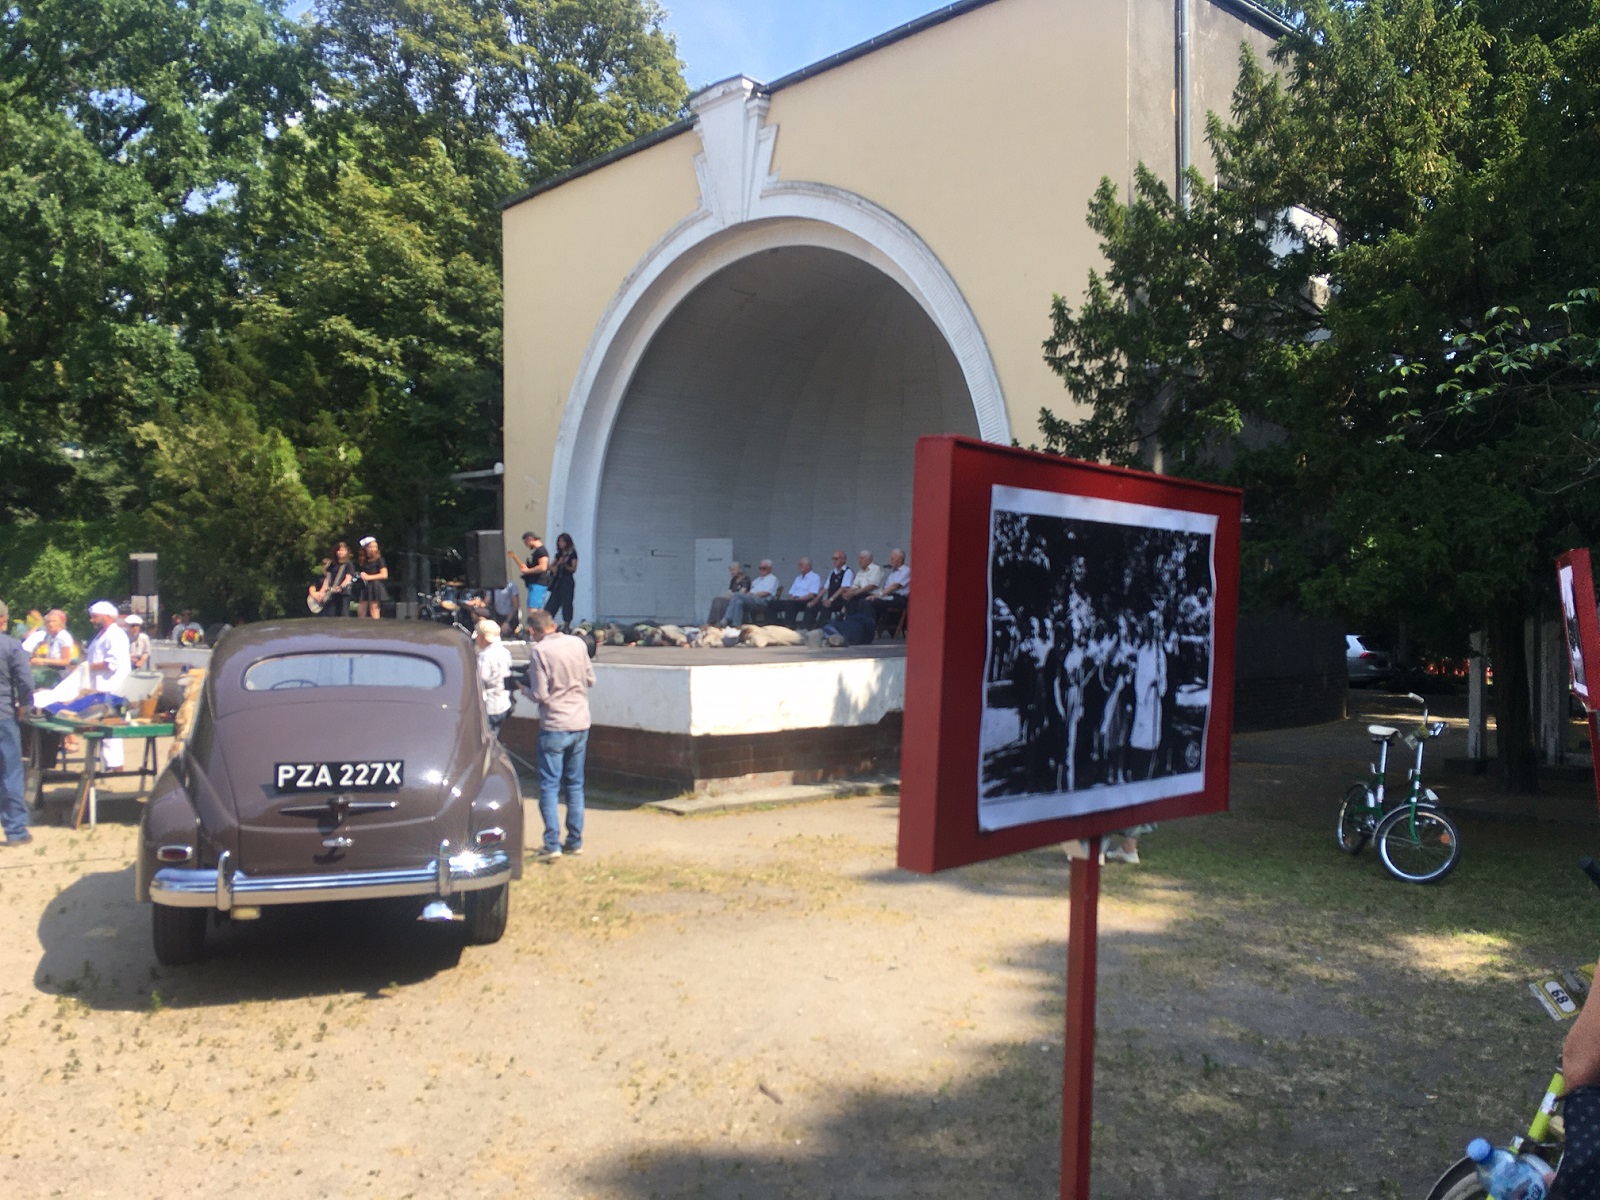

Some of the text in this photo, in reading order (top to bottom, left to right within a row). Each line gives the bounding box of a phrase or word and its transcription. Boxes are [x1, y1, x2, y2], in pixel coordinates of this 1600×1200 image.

[277, 762, 402, 788] PZA 227X
[1551, 989, 1569, 1004] 68
